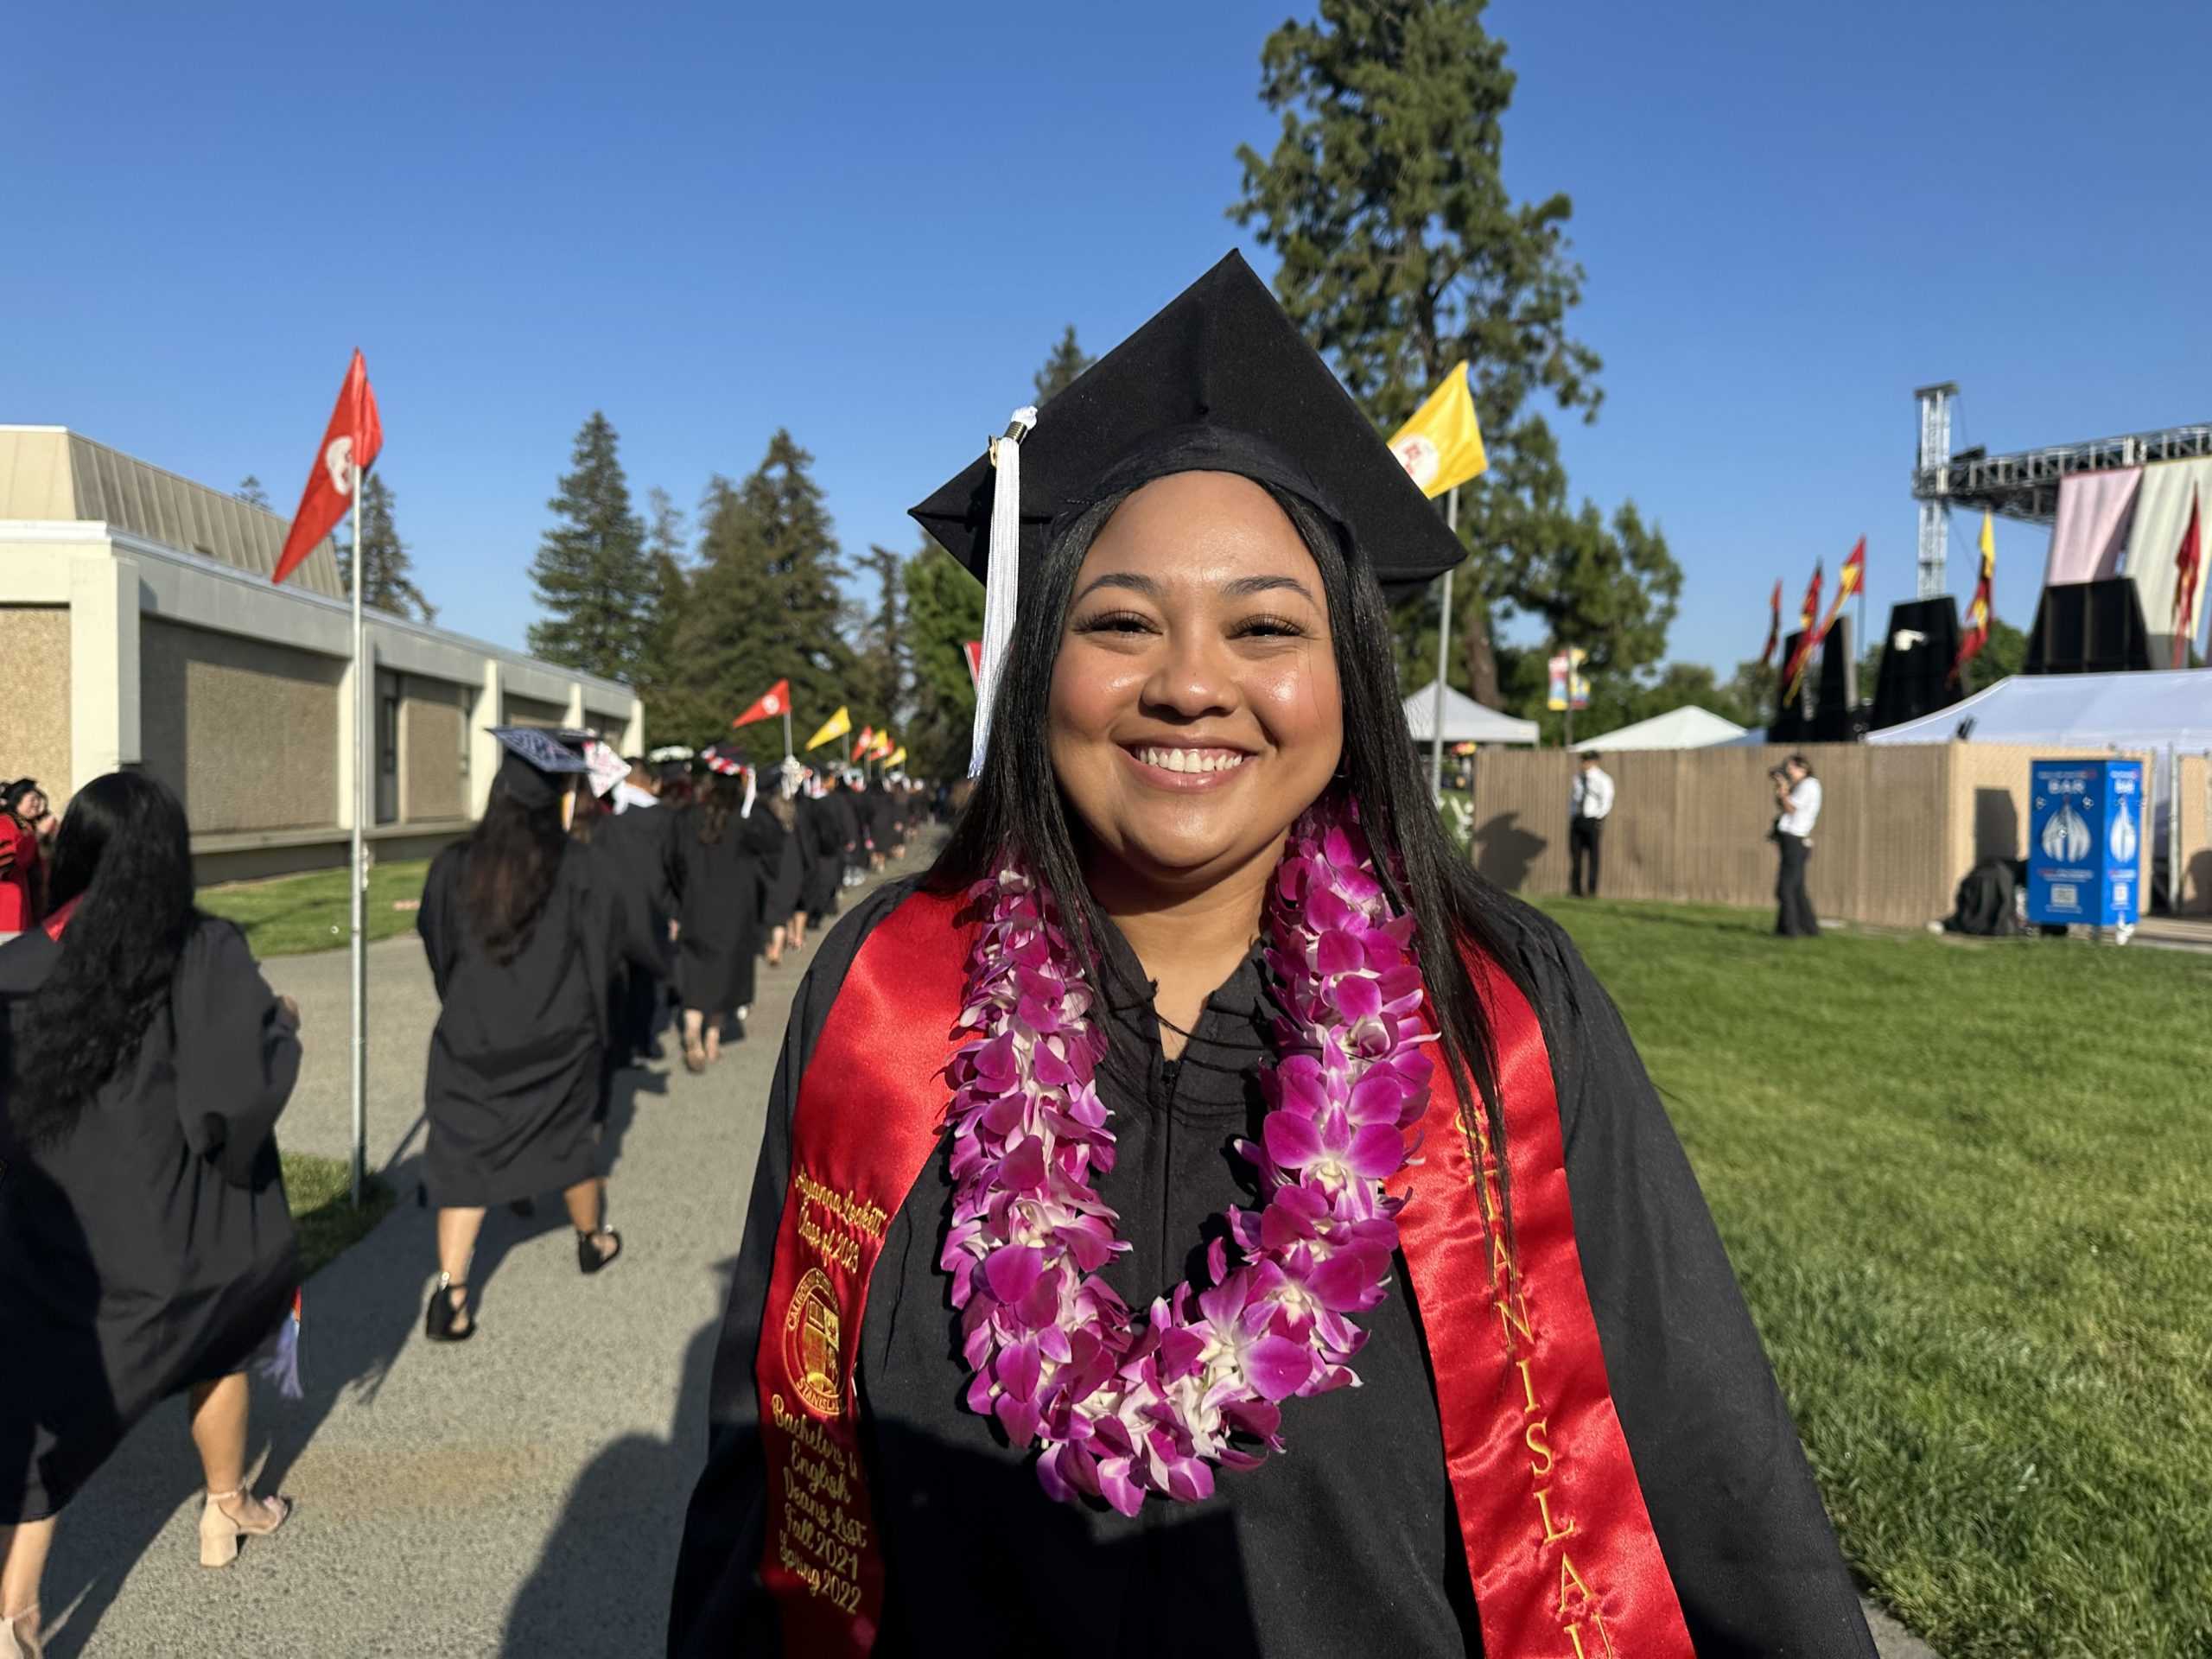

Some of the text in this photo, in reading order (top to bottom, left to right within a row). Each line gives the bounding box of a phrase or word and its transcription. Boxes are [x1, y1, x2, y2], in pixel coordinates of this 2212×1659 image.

[791, 1440, 851, 1503] English
[815, 1531, 859, 1580] 2021
[822, 1570, 862, 1615] 2022
